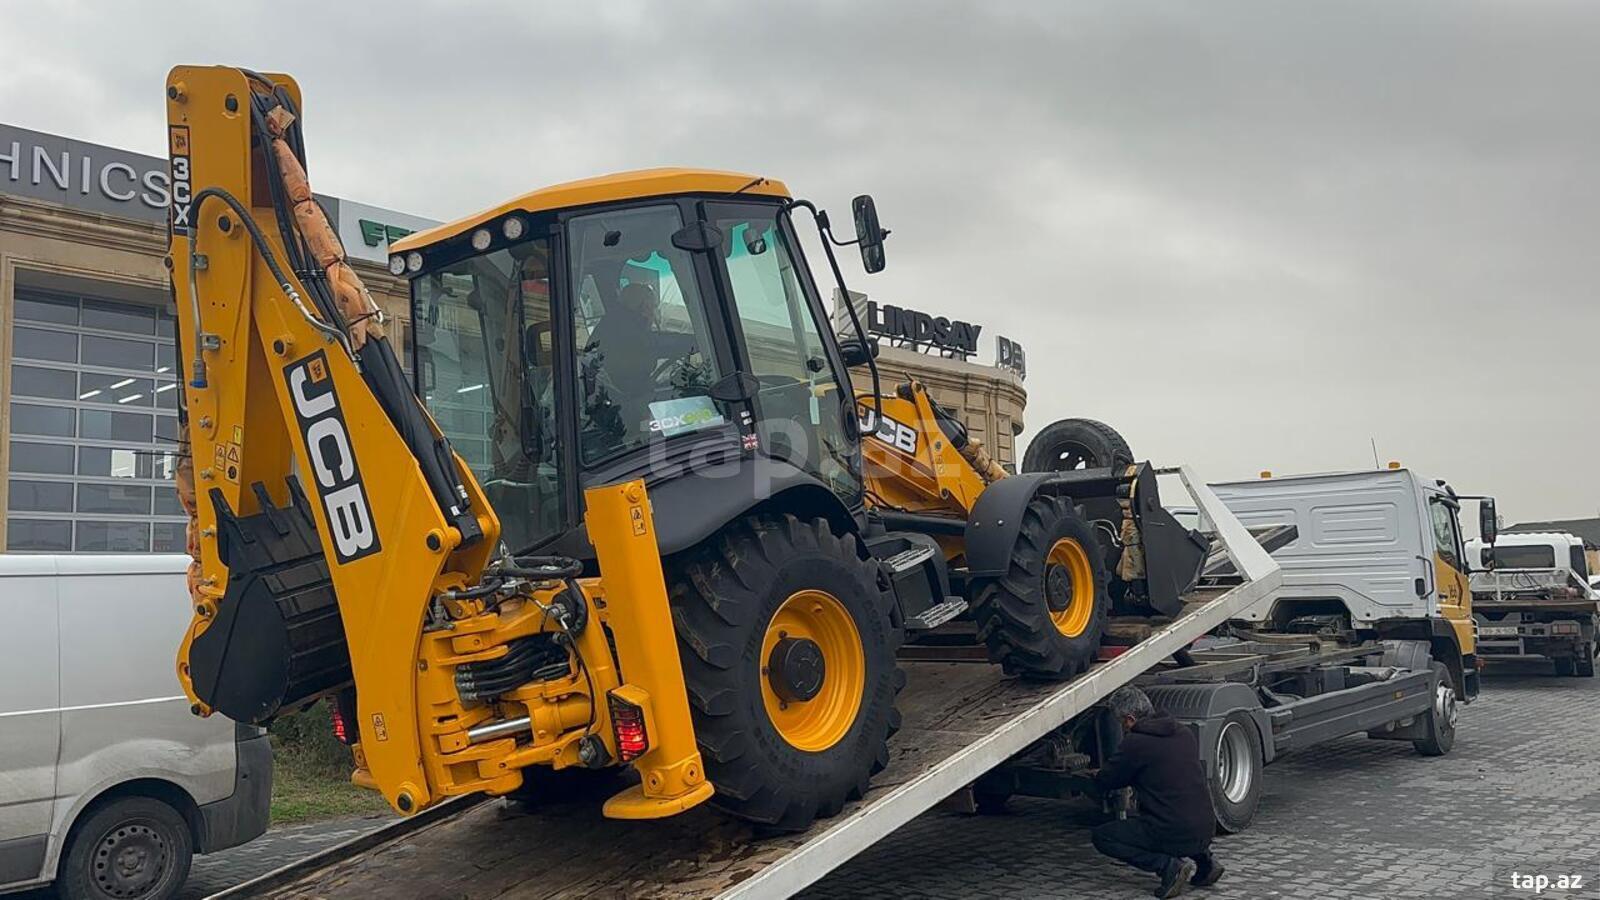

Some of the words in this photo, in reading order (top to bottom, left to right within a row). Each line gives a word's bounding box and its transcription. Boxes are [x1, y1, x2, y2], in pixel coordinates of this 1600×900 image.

[173, 157, 191, 225] 3CX
[359, 219, 418, 247] FE
[867, 301, 982, 351] LINDSAY
[859, 410, 917, 453] JCB
[291, 366, 373, 557] JCB
